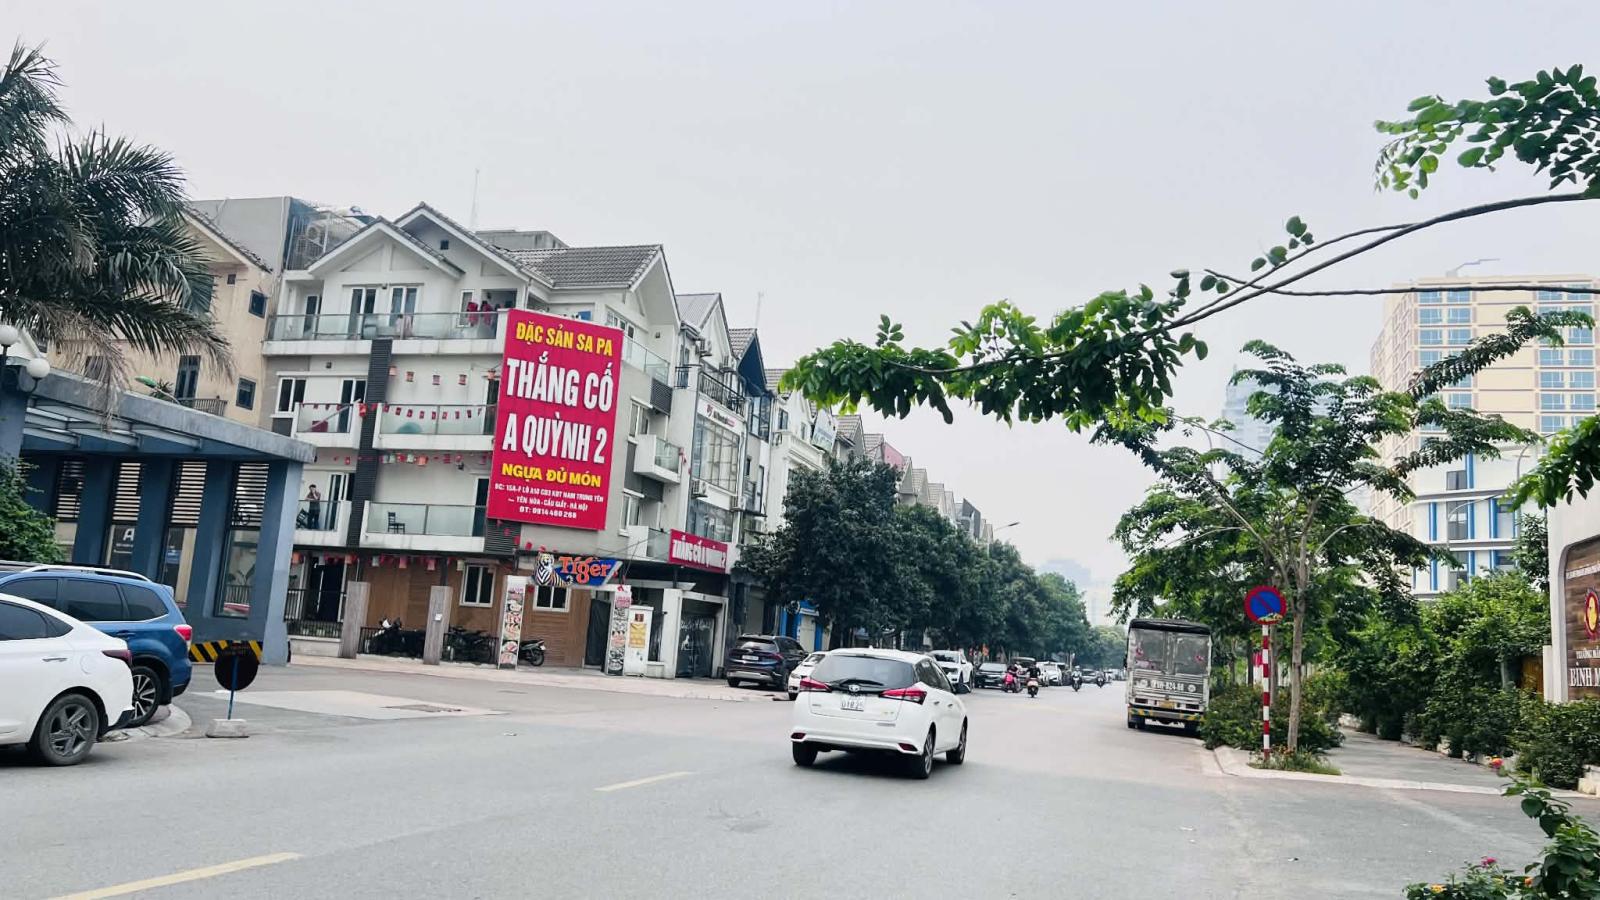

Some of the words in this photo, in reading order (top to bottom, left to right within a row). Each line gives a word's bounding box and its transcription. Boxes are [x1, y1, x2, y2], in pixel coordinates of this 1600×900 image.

[516, 321, 544, 345] ĐẶC
[546, 324, 574, 349] SẢN
[576, 333, 593, 353] SA
[596, 337, 613, 357] PA
[506, 351, 580, 407] THẮNG
[584, 362, 614, 412] CỐ
[502, 413, 517, 451] A
[522, 411, 592, 462] QUỲNH
[593, 427, 608, 464] 2
[502, 463, 542, 482] NGỰA
[546, 467, 567, 483] ĐỦ
[569, 471, 602, 487] MÓN
[559, 556, 611, 584] Tiger
